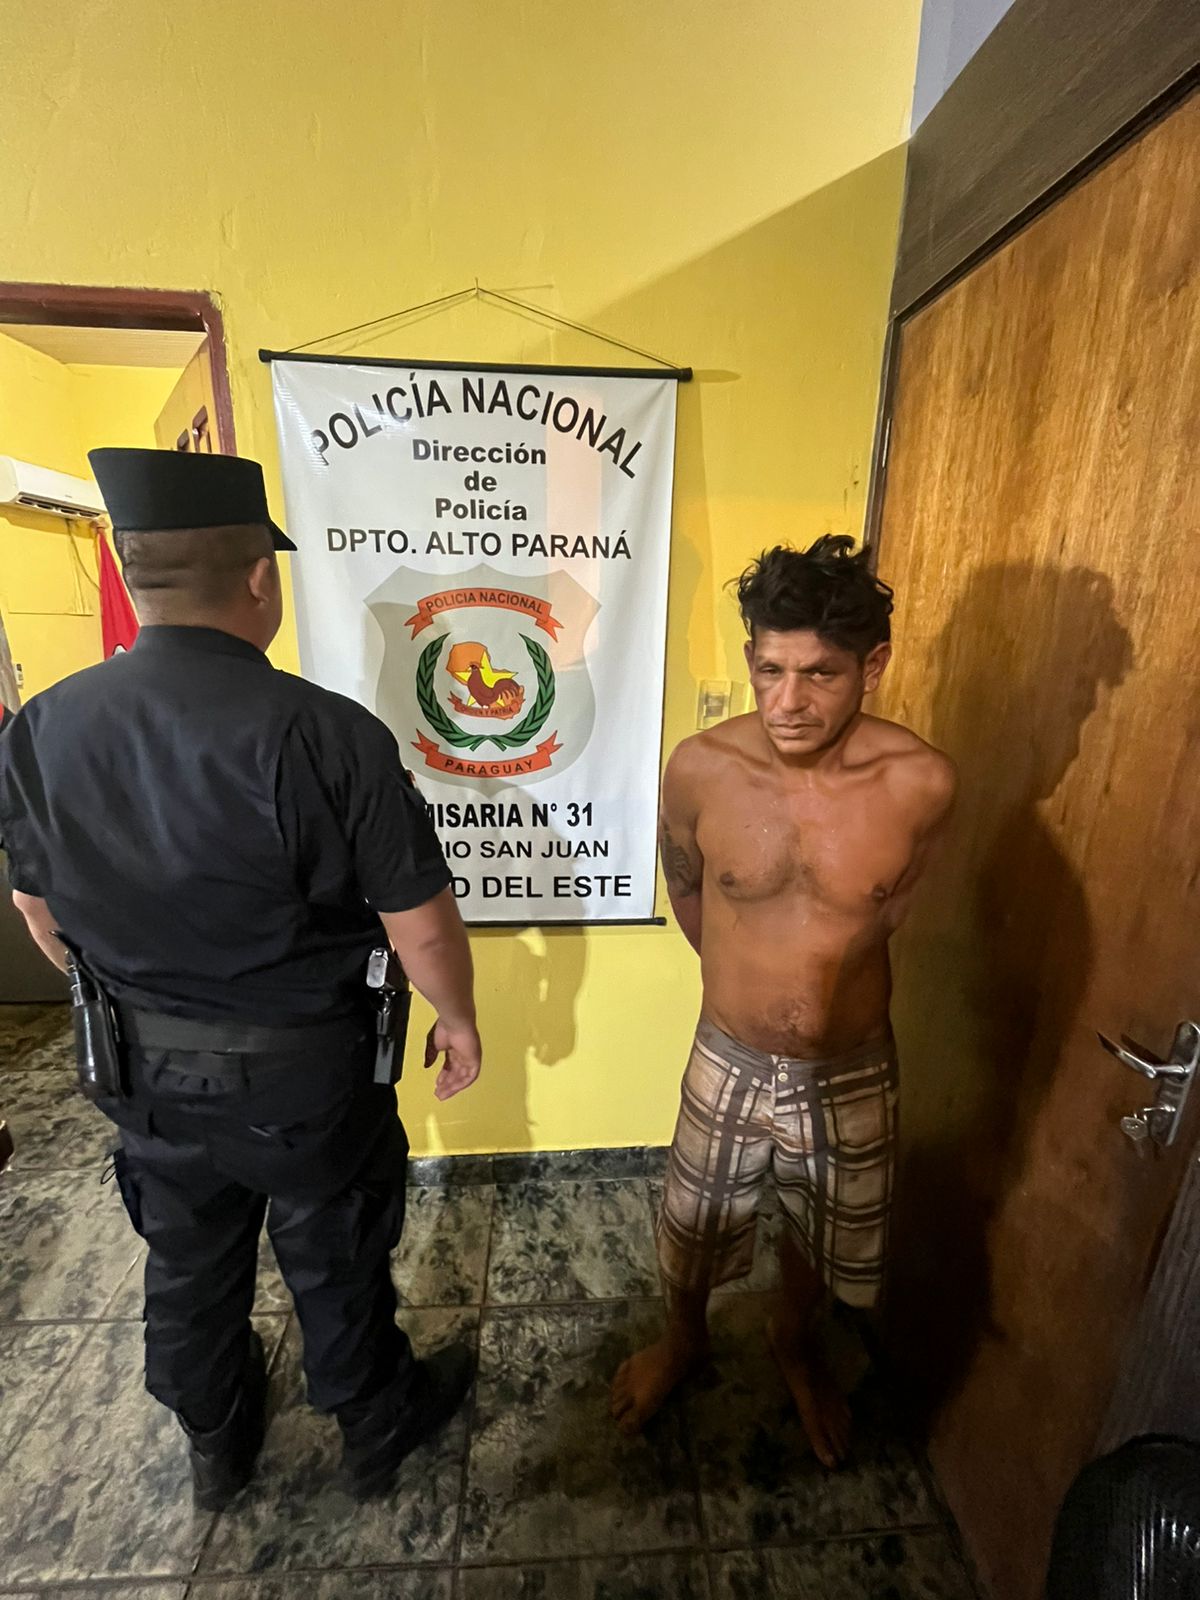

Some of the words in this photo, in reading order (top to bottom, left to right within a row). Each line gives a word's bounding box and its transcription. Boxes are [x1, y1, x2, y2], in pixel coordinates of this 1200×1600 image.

[311, 372, 451, 466] POLICÍA
[462, 377, 643, 479] NACIONAL
[412, 438, 547, 465] Dirección
[463, 470, 498, 492] de
[435, 497, 528, 521] Policía
[326, 527, 417, 554] DPTO.
[425, 531, 502, 556] ALTO
[511, 530, 632, 559] PARANÁ
[425, 592, 477, 612] POLICIA
[479, 591, 543, 614] NACIONAL
[445, 759, 533, 775] PARAGUAY
[566, 802, 593, 827] 31
[480, 840, 533, 859] SAN
[541, 840, 609, 858] JUAN
[482, 876, 543, 898] DEL
[553, 875, 632, 898] ESTE
